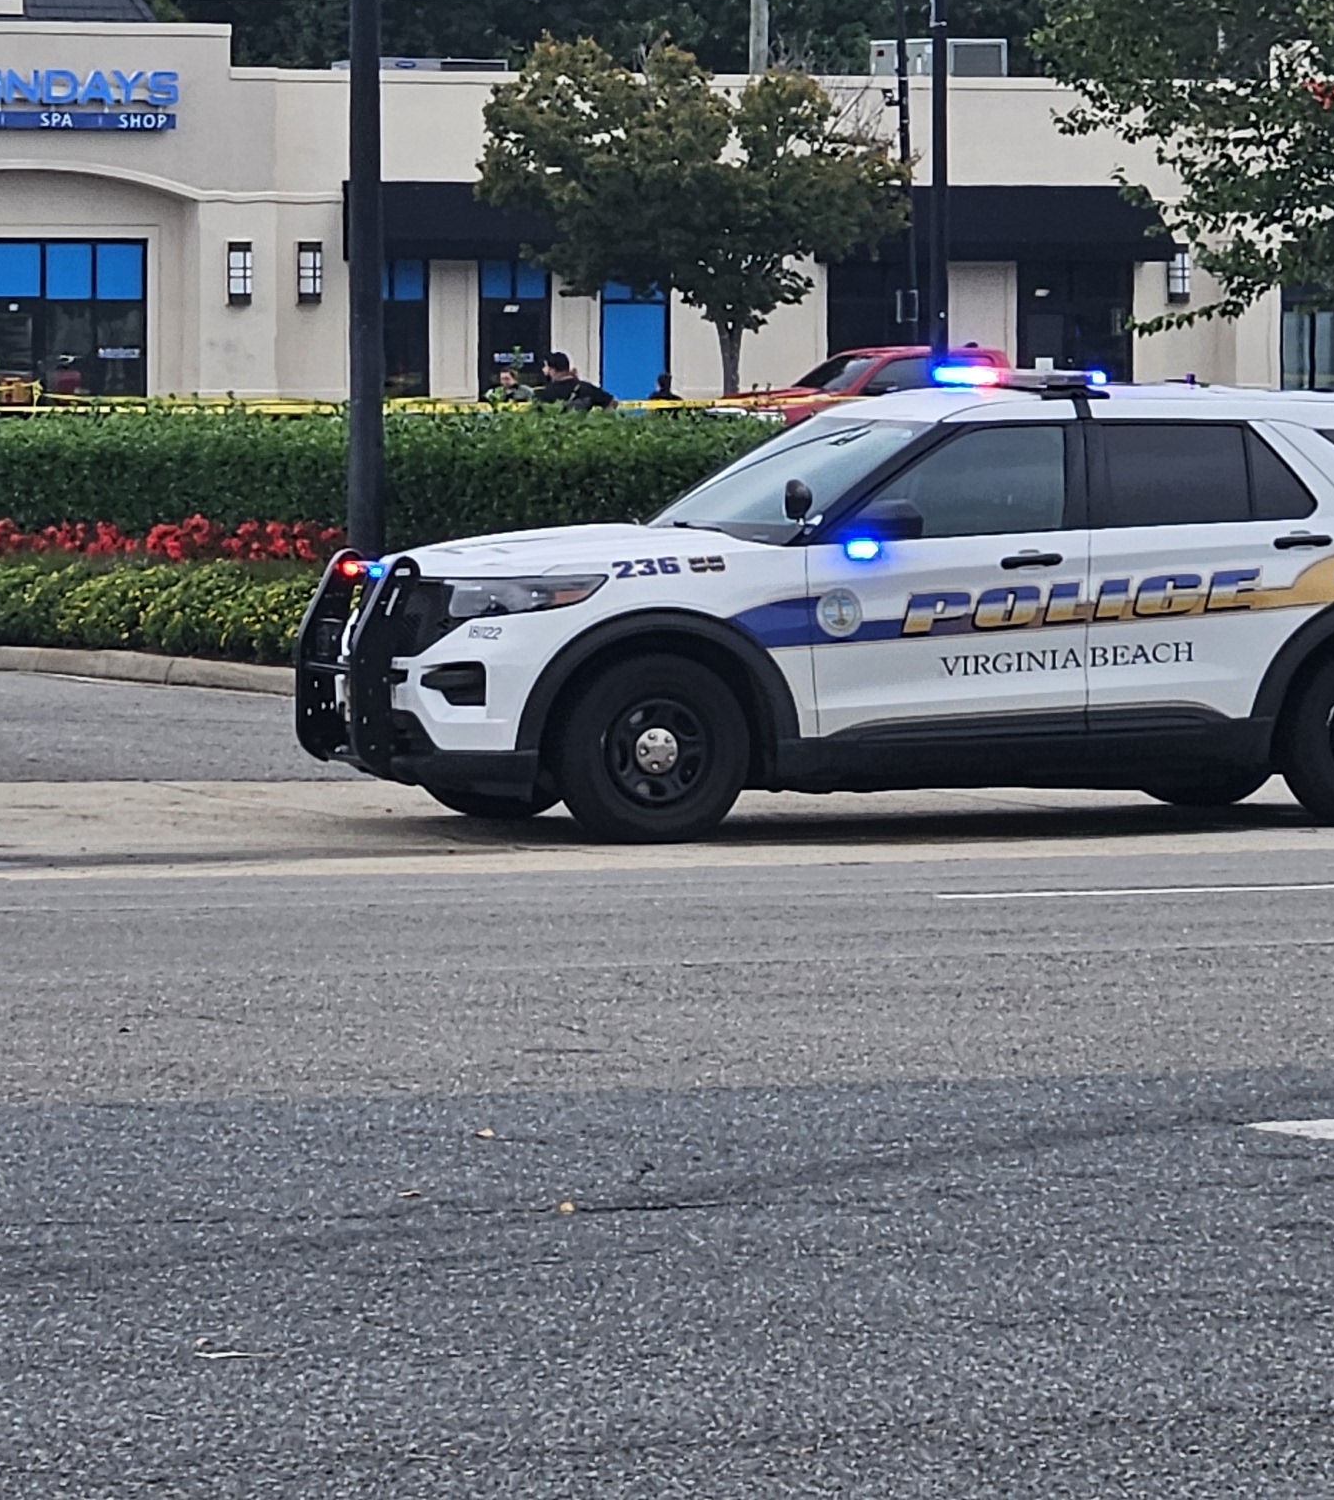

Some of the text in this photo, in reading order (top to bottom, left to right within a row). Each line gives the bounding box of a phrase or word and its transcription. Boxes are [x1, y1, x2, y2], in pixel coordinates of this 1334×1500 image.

[39, 113, 73, 127] SPA
[118, 113, 167, 128] SHOP
[612, 557, 681, 579] 236
[901, 567, 1263, 638] POLICE
[941, 641, 1194, 676] VIRGINIA BEACH
